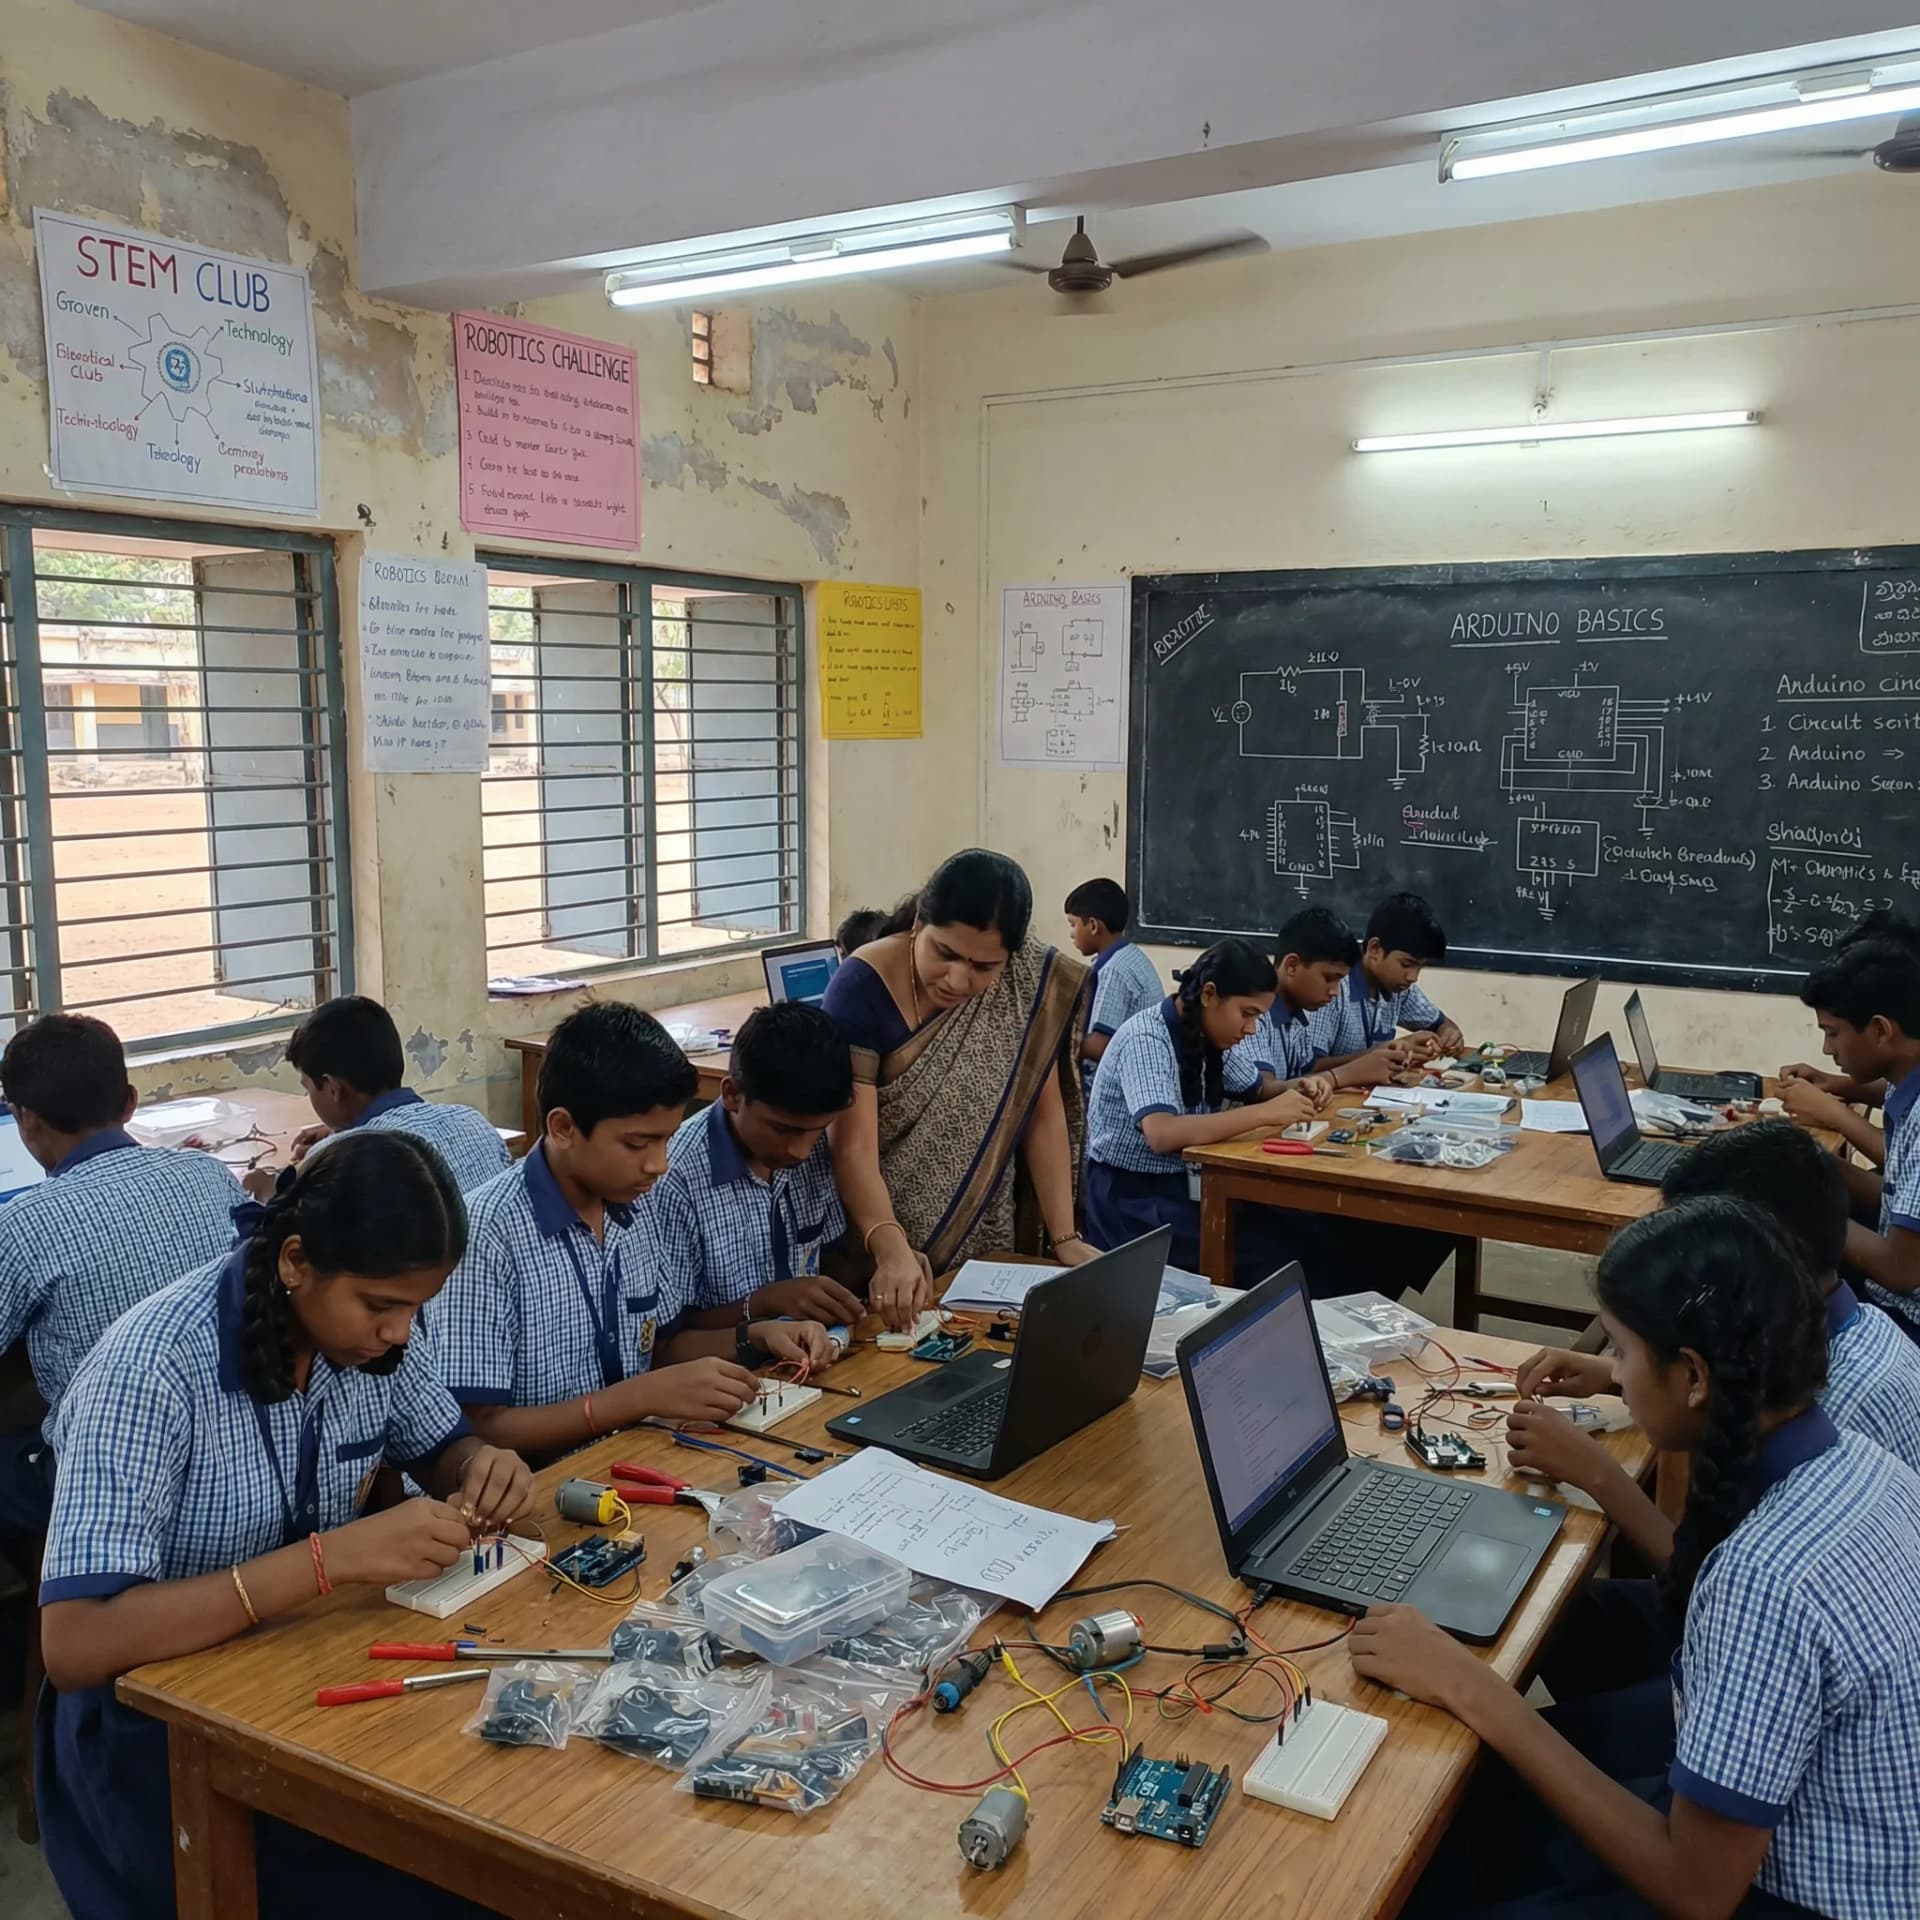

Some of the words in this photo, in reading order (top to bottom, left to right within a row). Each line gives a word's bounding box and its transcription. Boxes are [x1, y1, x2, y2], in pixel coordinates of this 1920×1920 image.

[77, 235, 178, 295] STEM
[196, 262, 270, 312] CLUB
[223, 319, 294, 356] Technology
[464, 323, 546, 364] ROBOTICS
[552, 344, 630, 384] CHALLENGE
[1450, 610, 1560, 640] ARDUINO
[1576, 608, 1665, 634] BASICS
[1776, 673, 1866, 695] Arduino
[1788, 744, 1866, 761] Arduino
[1787, 772, 1861, 791] Arduino
